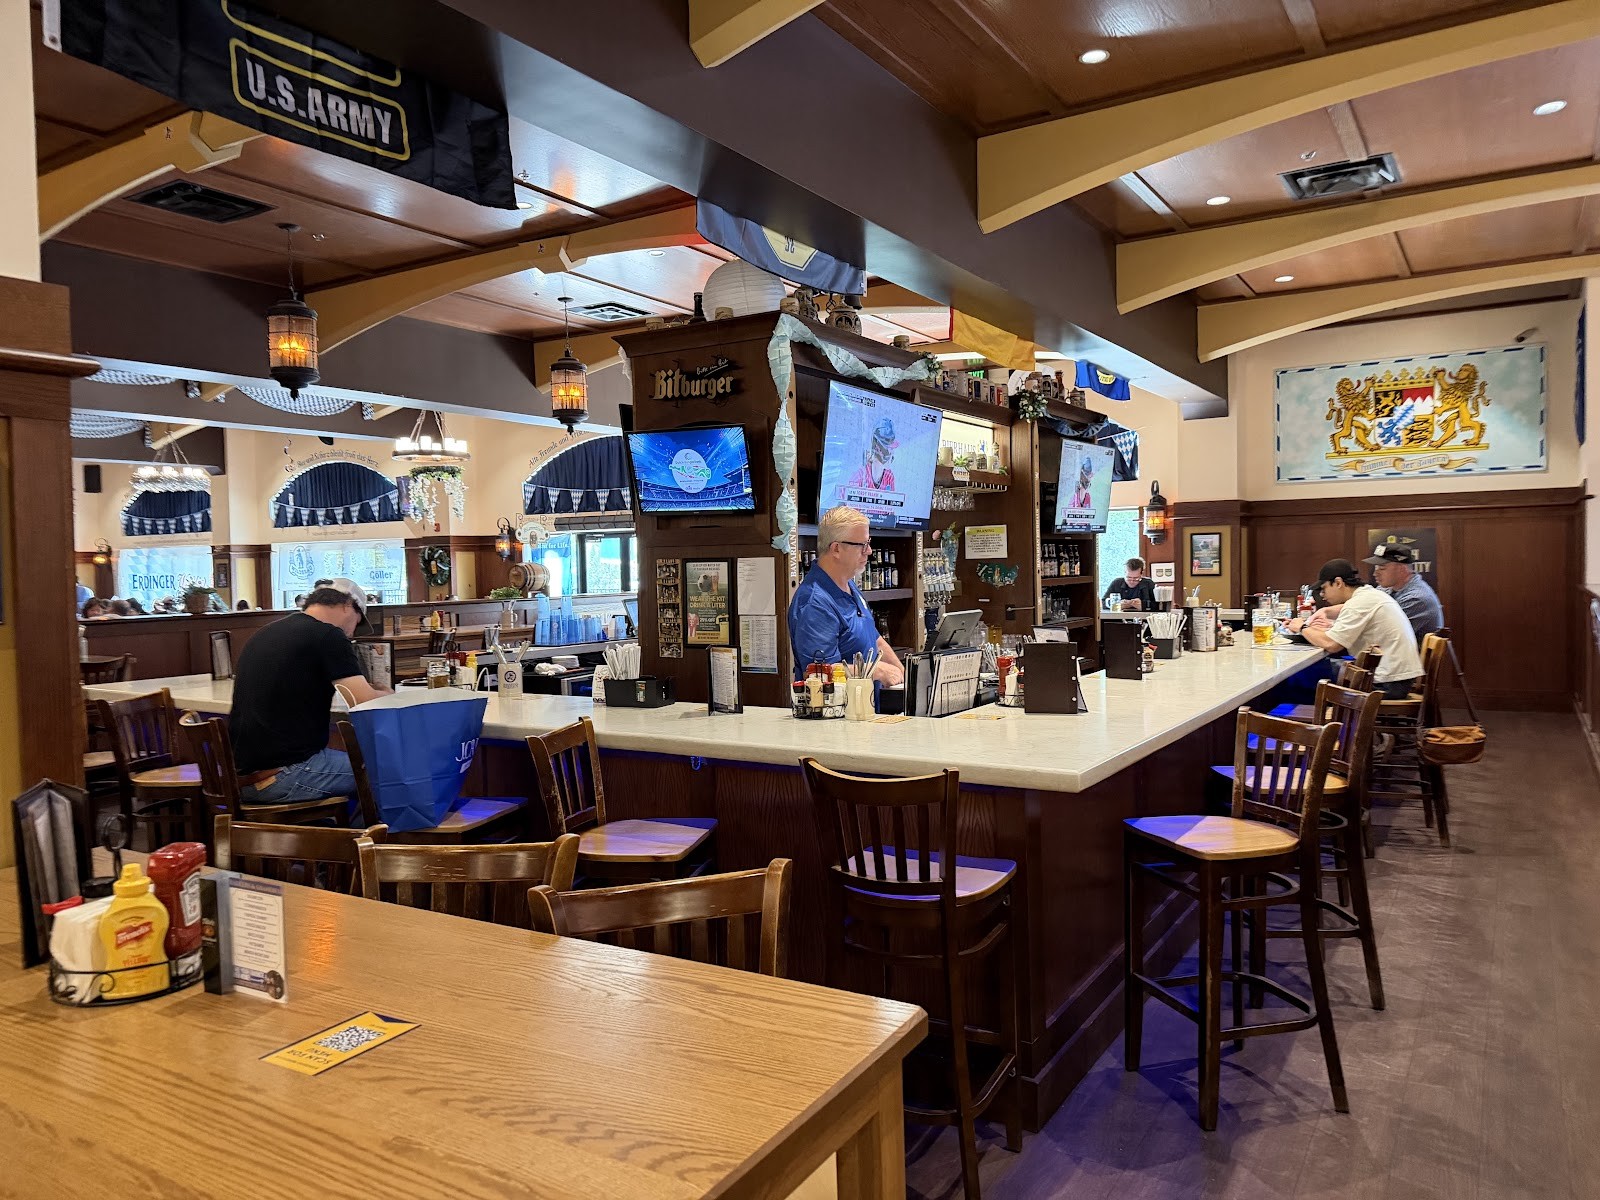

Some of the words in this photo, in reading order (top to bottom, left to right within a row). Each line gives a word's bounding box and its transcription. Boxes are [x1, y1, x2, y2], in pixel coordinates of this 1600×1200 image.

[653, 368, 735, 400] Bitburger
[132, 574, 176, 591] ERDINGER
[307, 1054, 332, 1065] SCAN
